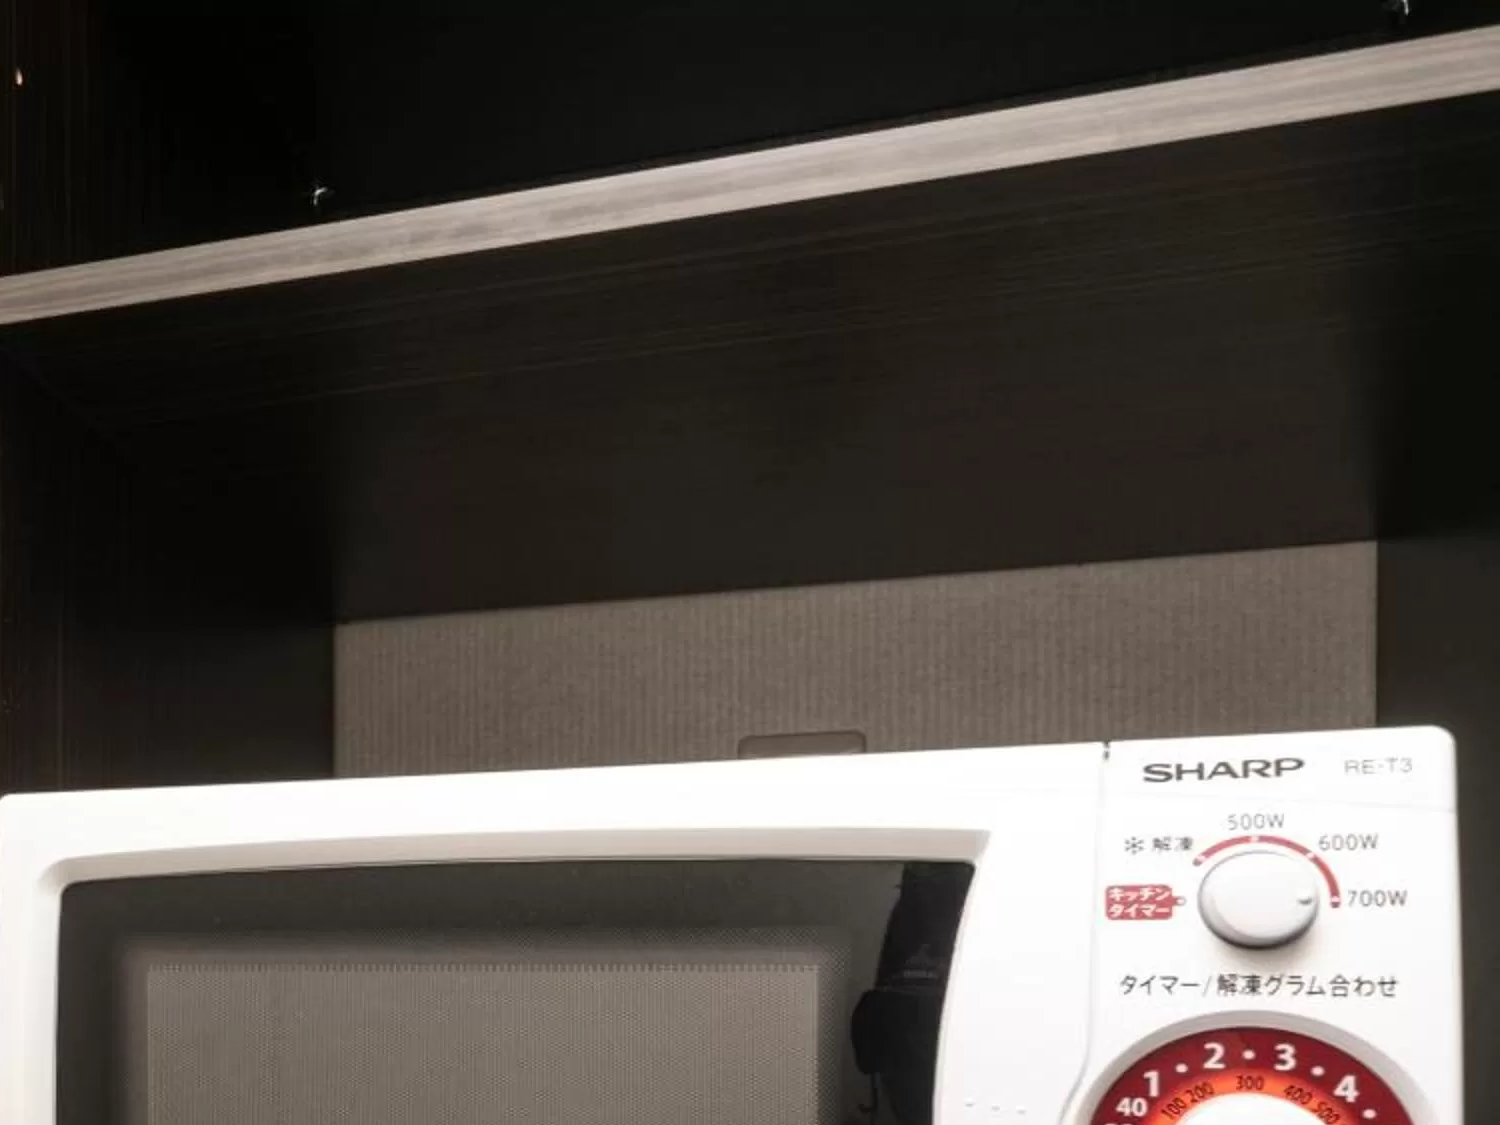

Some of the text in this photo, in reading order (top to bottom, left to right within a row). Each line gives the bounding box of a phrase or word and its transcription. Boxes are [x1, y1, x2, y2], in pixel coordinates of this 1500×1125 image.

[1143, 757, 1306, 783] SHARP
[1227, 813, 1286, 831] 500W
[1151, 836, 1195, 852] 解凍
[1318, 833, 1380, 851] 600W
[1107, 886, 1172, 902] キッチン
[1347, 889, 1409, 908] 700W
[1107, 904, 1171, 919] タイマー
[1116, 1097, 1148, 1117] 40
[1143, 1070, 1161, 1098] 1
[1203, 1042, 1226, 1069] 2
[1274, 1043, 1297, 1072] 3
[1332, 1074, 1360, 1104] 4
[1161, 1096, 1186, 1122] 100
[1187, 1081, 1216, 1105] 200
[1235, 1074, 1265, 1091] 300
[1283, 1084, 1313, 1106] 400
